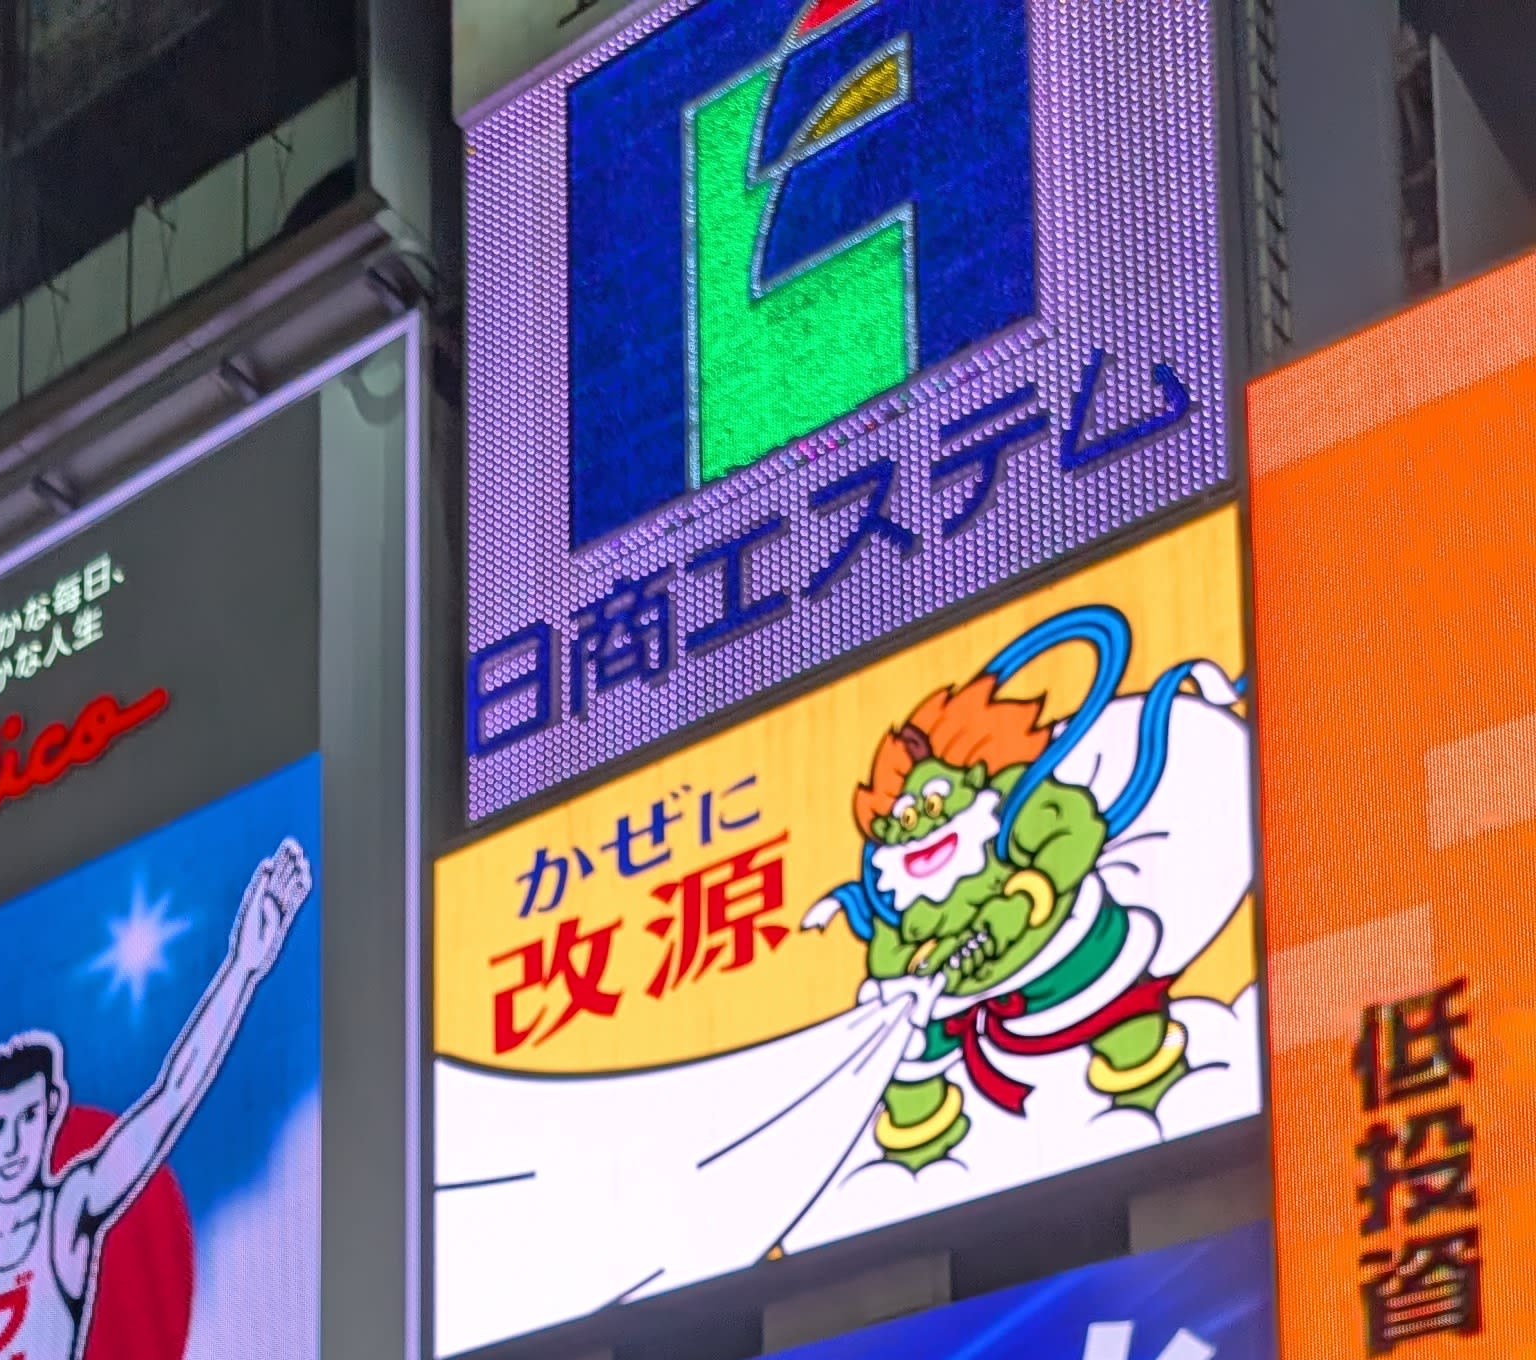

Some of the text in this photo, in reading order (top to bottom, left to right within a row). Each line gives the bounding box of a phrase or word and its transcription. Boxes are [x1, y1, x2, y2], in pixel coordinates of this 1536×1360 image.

[467, 348, 1196, 756] 日商エステム
[488, 828, 791, 1055] 改源
[514, 775, 762, 918] かぜに
[1353, 975, 1477, 1360] 低投資
